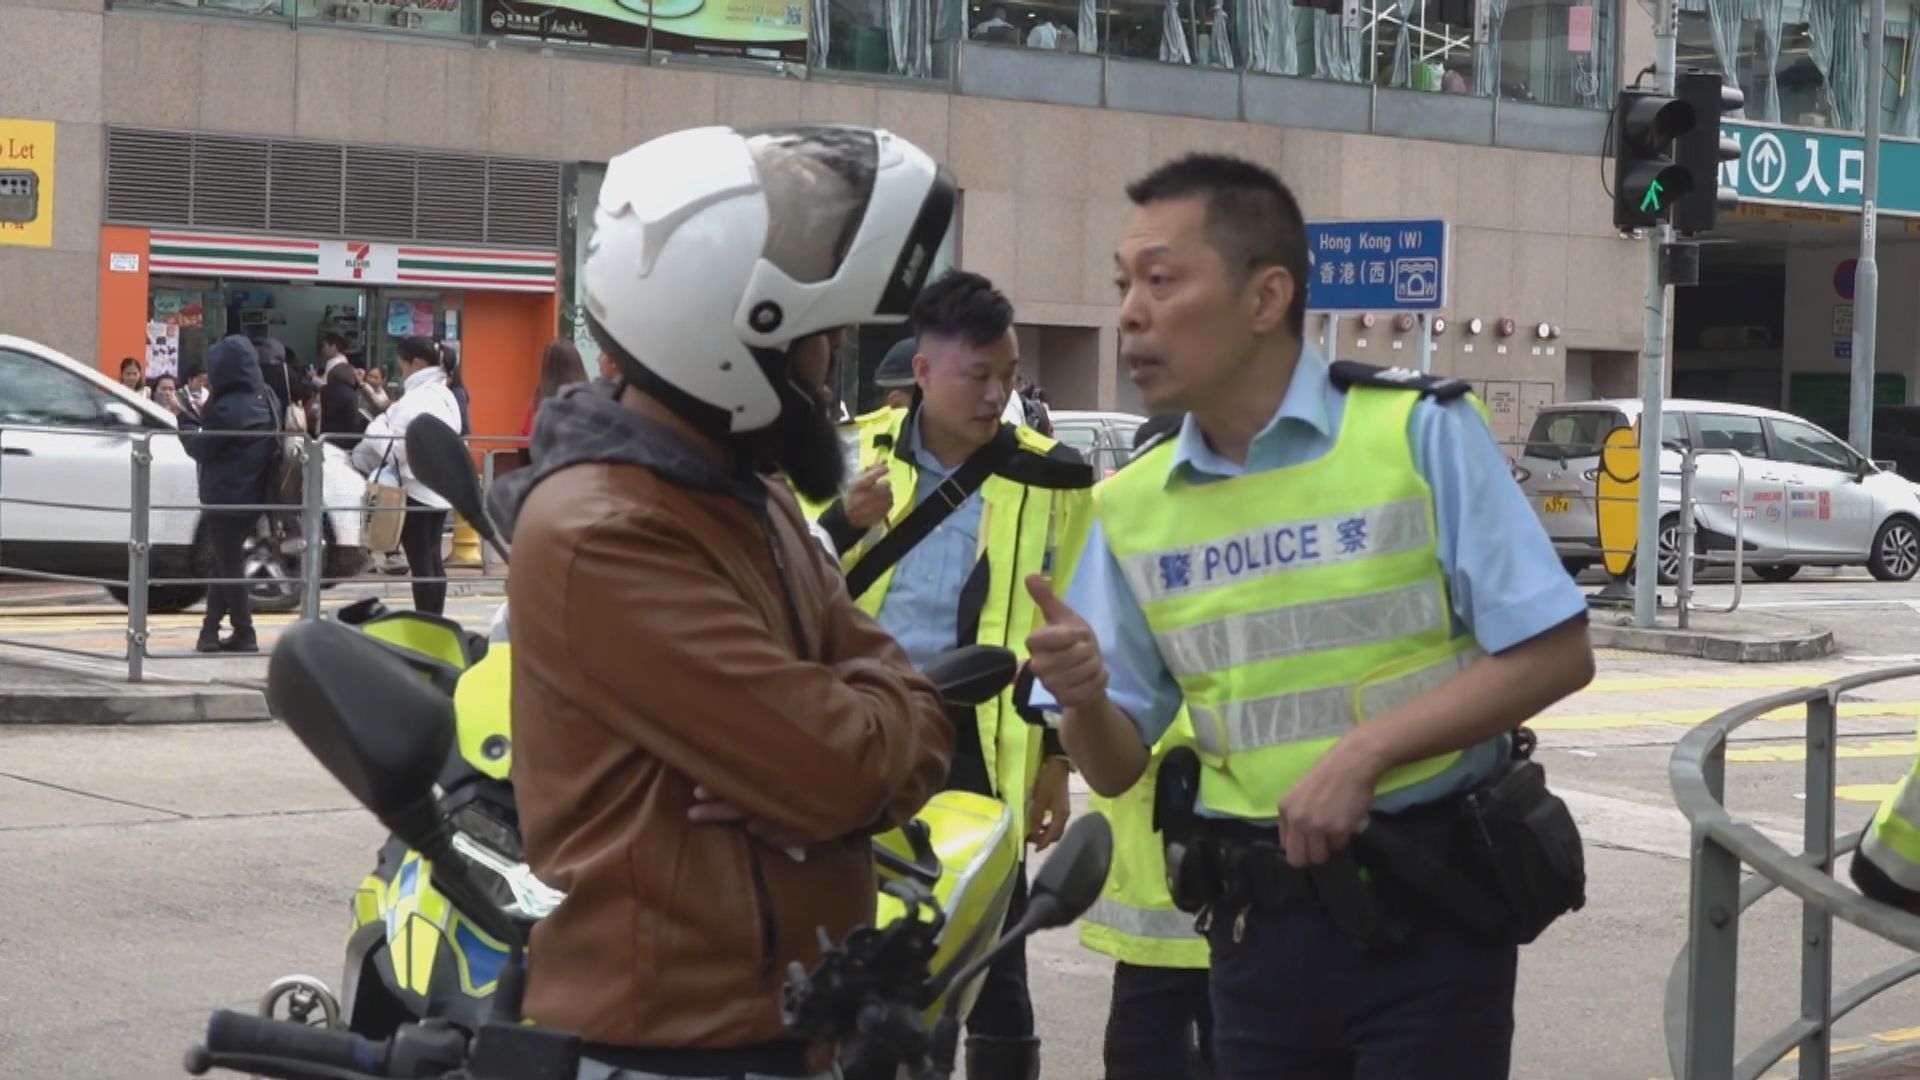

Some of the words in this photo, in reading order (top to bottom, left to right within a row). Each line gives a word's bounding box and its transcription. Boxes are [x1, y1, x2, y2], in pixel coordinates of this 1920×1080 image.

[8, 138, 35, 159] Let
[1795, 139, 1864, 197] 入口
[1320, 233, 1351, 253] Hong
[1360, 232, 1391, 253] Kong
[1399, 230, 1422, 249] (W)
[1159, 552, 1191, 589] 警
[1204, 524, 1320, 580] POLICE
[1337, 517, 1367, 553] 察
